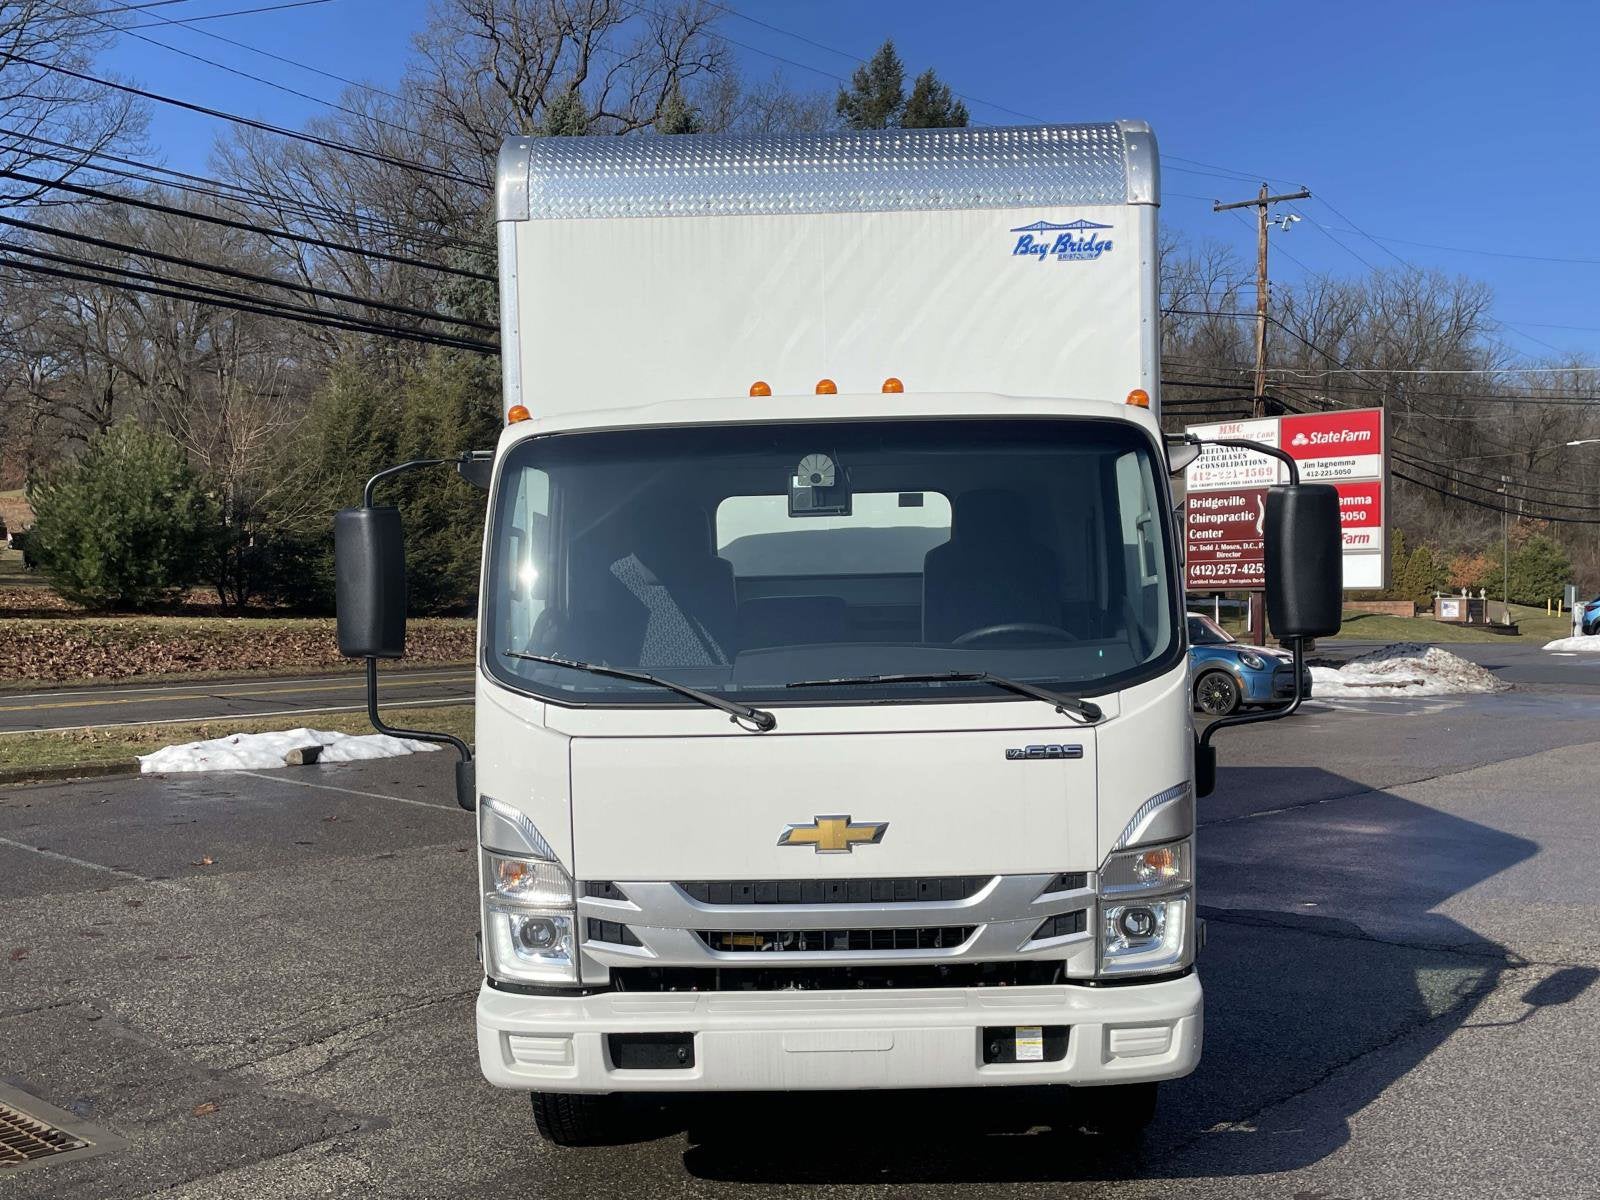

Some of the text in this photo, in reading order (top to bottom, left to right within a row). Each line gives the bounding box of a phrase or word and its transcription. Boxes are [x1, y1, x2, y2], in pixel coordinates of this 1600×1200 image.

[1012, 232, 1113, 261] Bay Bridge
[1219, 424, 1244, 434] MMC
[1192, 467, 1273, 482] 412-221-1569
[1306, 468, 1352, 477] 412-221-5050
[1190, 496, 1246, 509] Bridgeville
[1190, 511, 1255, 524] Chiropractic
[1189, 529, 1224, 539] Center
[1190, 564, 1216, 577] (412)
[1025, 744, 1083, 759] GAS
